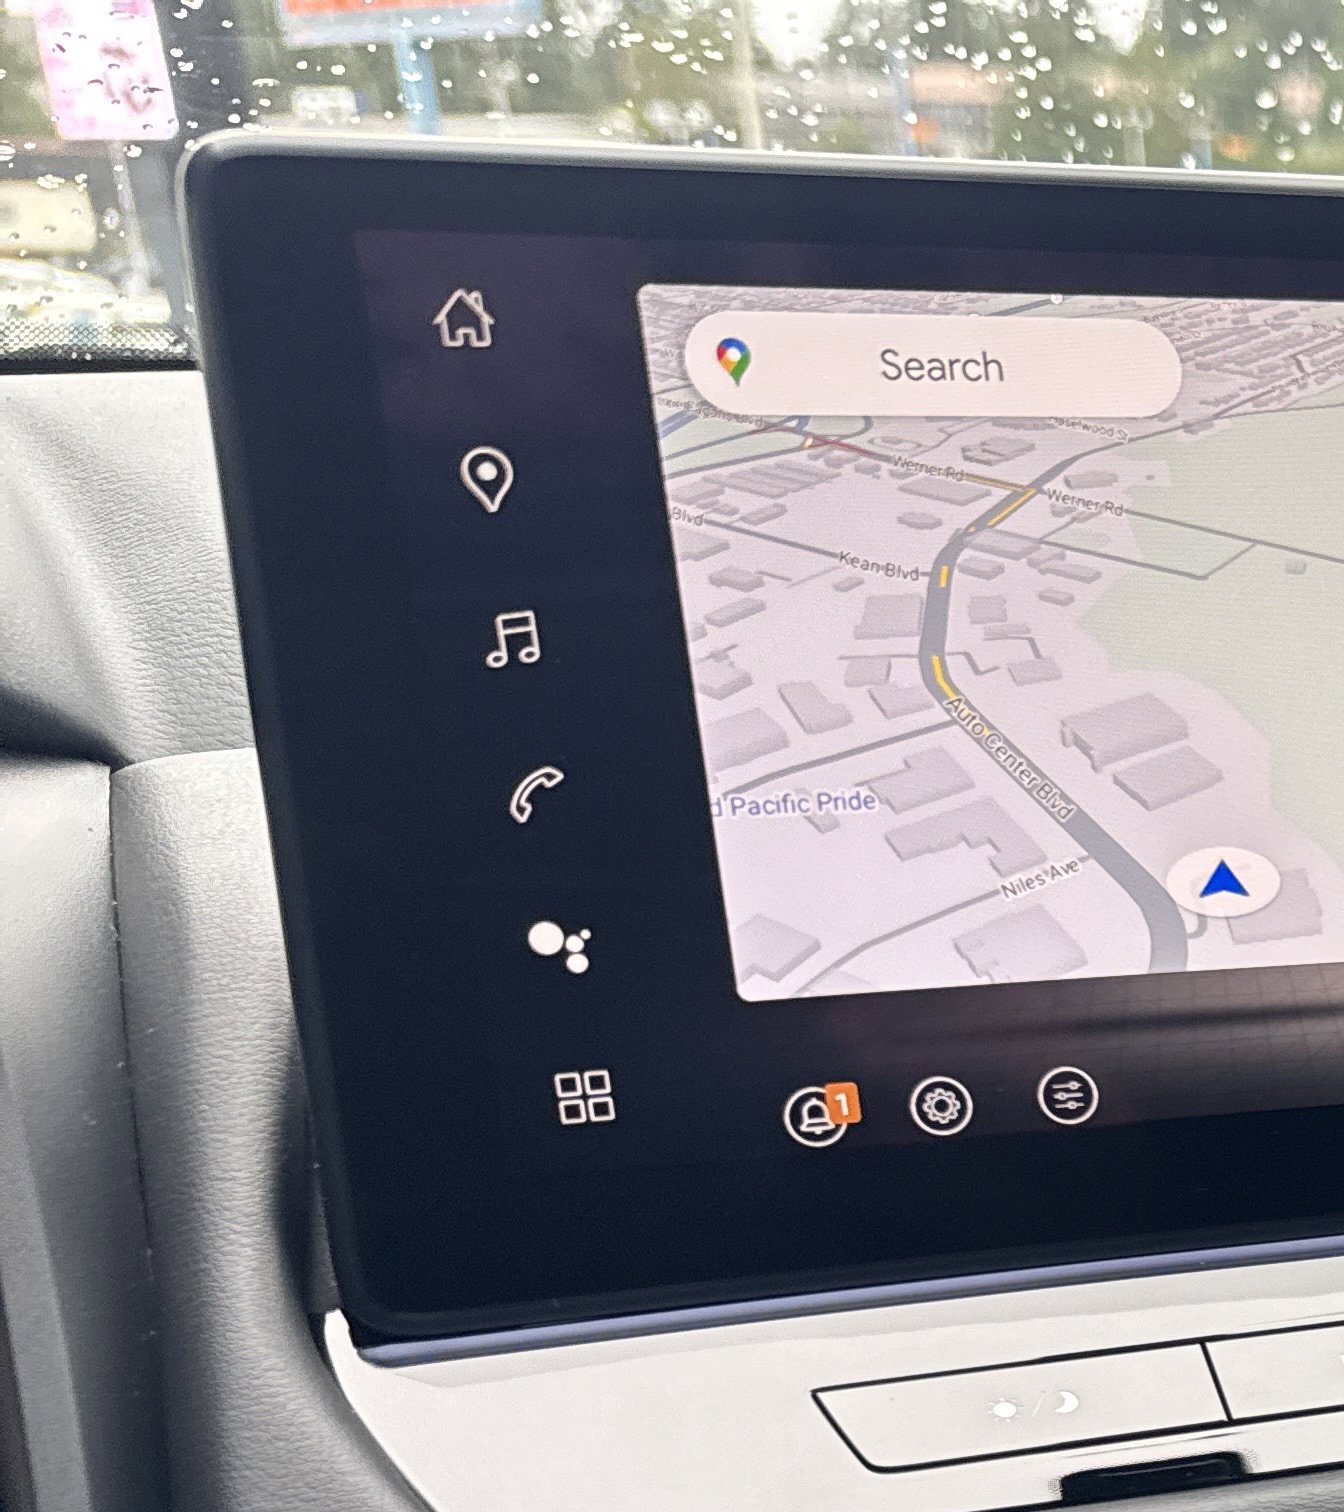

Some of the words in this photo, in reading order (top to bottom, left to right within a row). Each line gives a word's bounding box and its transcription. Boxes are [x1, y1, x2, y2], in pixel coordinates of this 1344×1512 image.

[880, 349, 1004, 383] Search
[894, 455, 942, 476] Werner
[945, 466, 964, 481] Rd
[1047, 488, 1100, 510] Werner
[1105, 501, 1123, 516] Rd
[671, 507, 705, 526] Blvd
[839, 550, 878, 575] Kean
[884, 560, 921, 582] Blvd
[945, 697, 985, 736] Auto
[985, 733, 1039, 786] Center
[1036, 782, 1074, 820] Blvd
[732, 794, 809, 816] Pacific
[818, 791, 876, 812] Pride
[1001, 871, 1045, 898] Niles
[1050, 858, 1081, 883] Ave
[834, 1092, 850, 1116] 1
